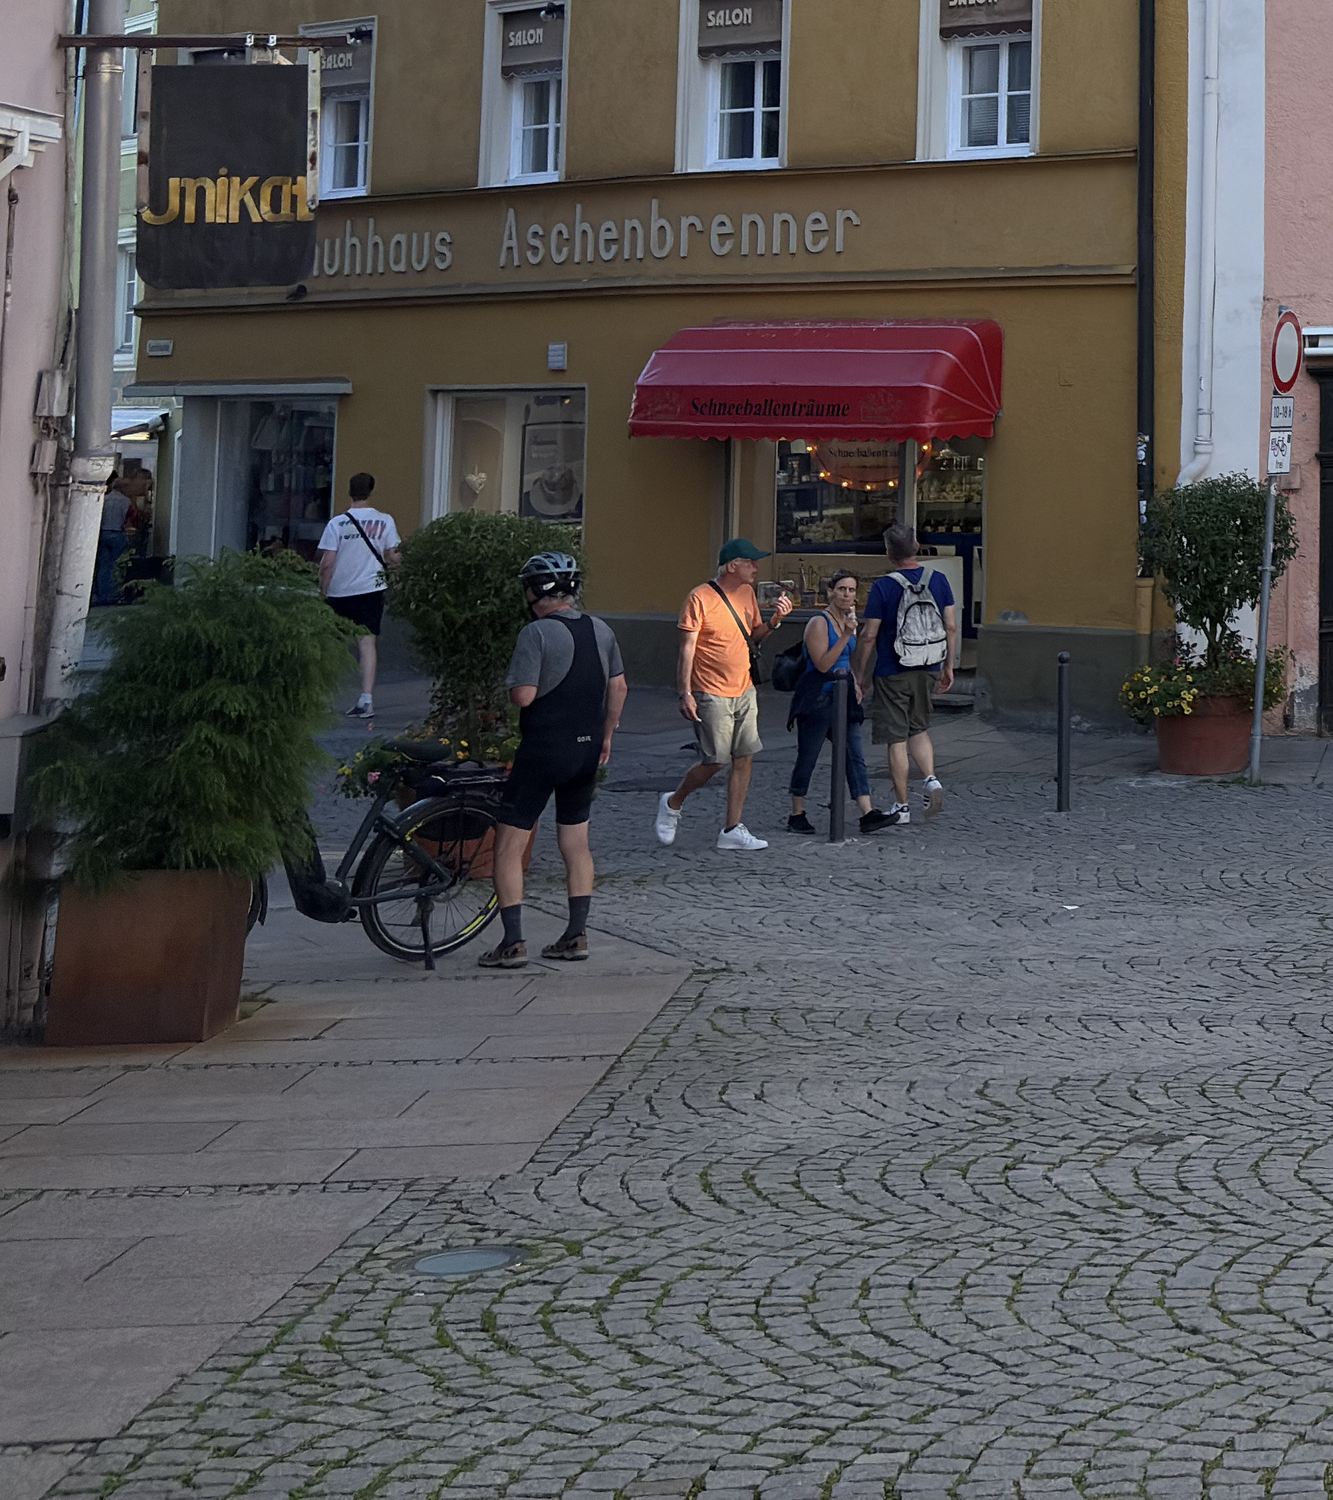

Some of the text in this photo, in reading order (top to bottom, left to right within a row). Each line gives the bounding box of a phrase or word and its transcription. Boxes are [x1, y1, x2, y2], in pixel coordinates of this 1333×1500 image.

[707, 7, 752, 28] SALON
[508, 28, 543, 48] SALON
[500, 198, 861, 268] Aschenbrenner
[690, 396, 850, 419] Schneeballenträume
